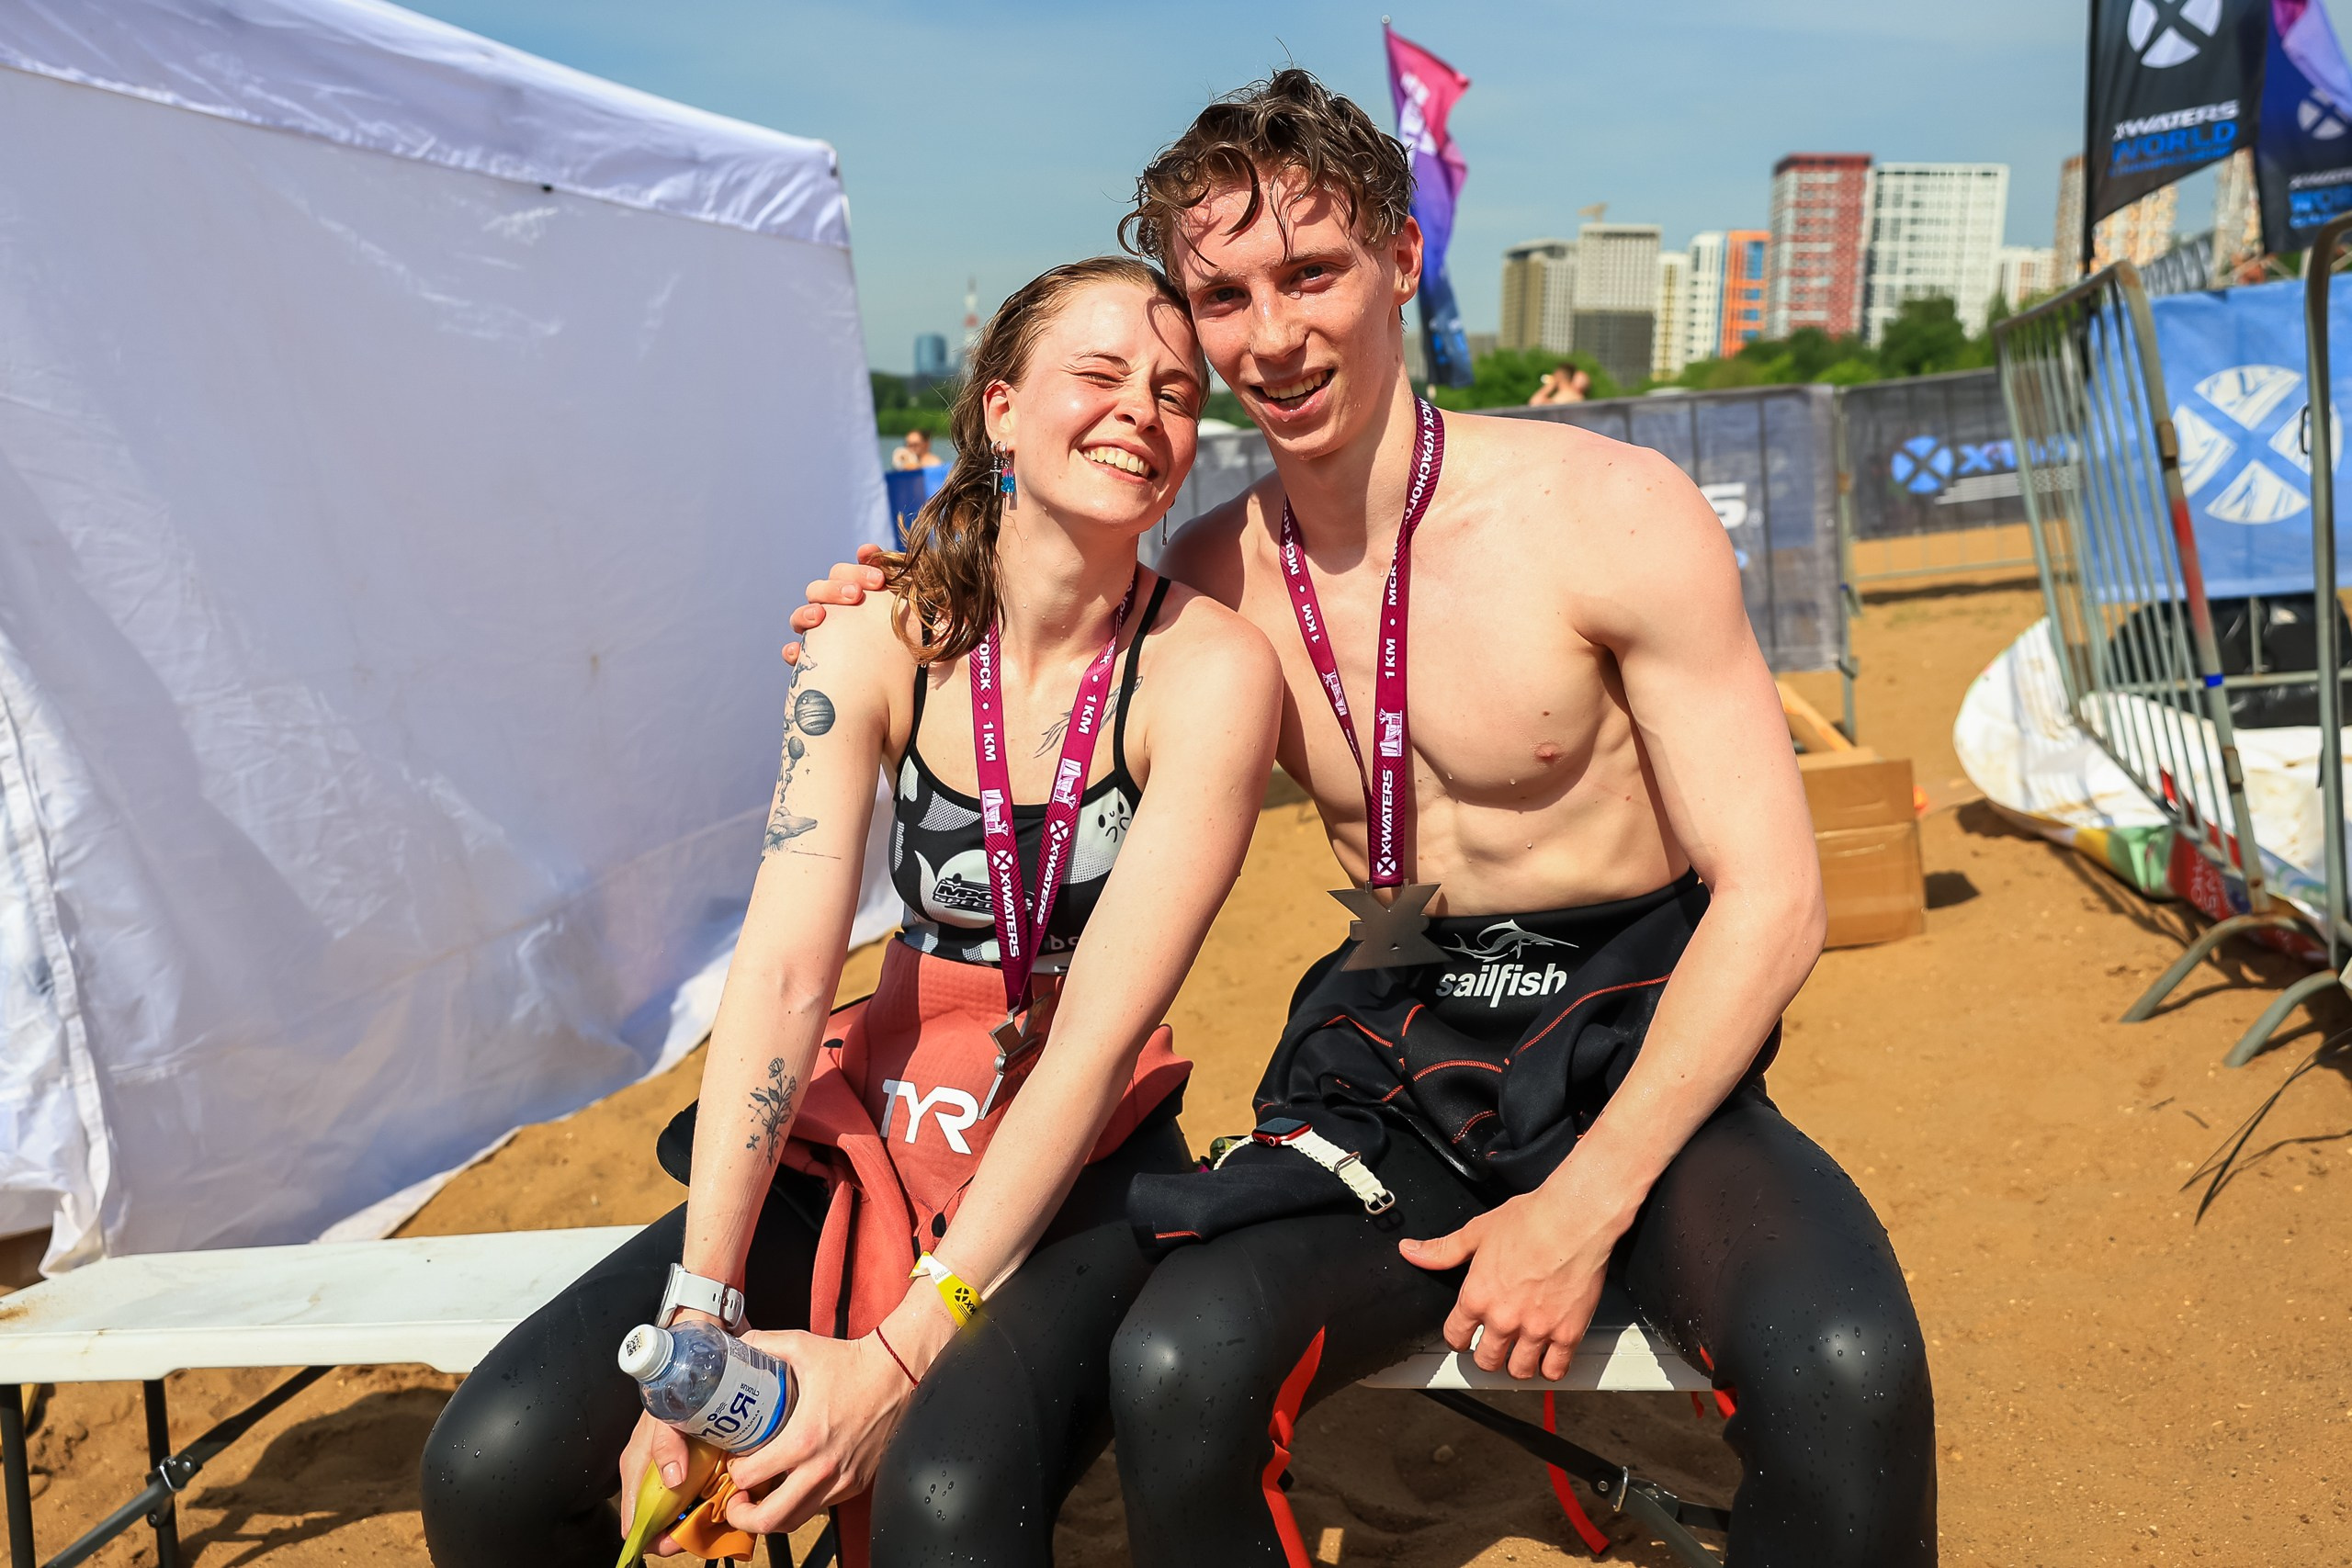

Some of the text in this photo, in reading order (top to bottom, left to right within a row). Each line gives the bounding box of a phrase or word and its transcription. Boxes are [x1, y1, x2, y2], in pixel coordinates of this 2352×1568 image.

[2113, 120, 2238, 163] WORLD
[1405, 429, 1435, 523] КРАСНОГО
[1436, 964, 1567, 1008] sailfish
[879, 1078, 973, 1155] TYR
